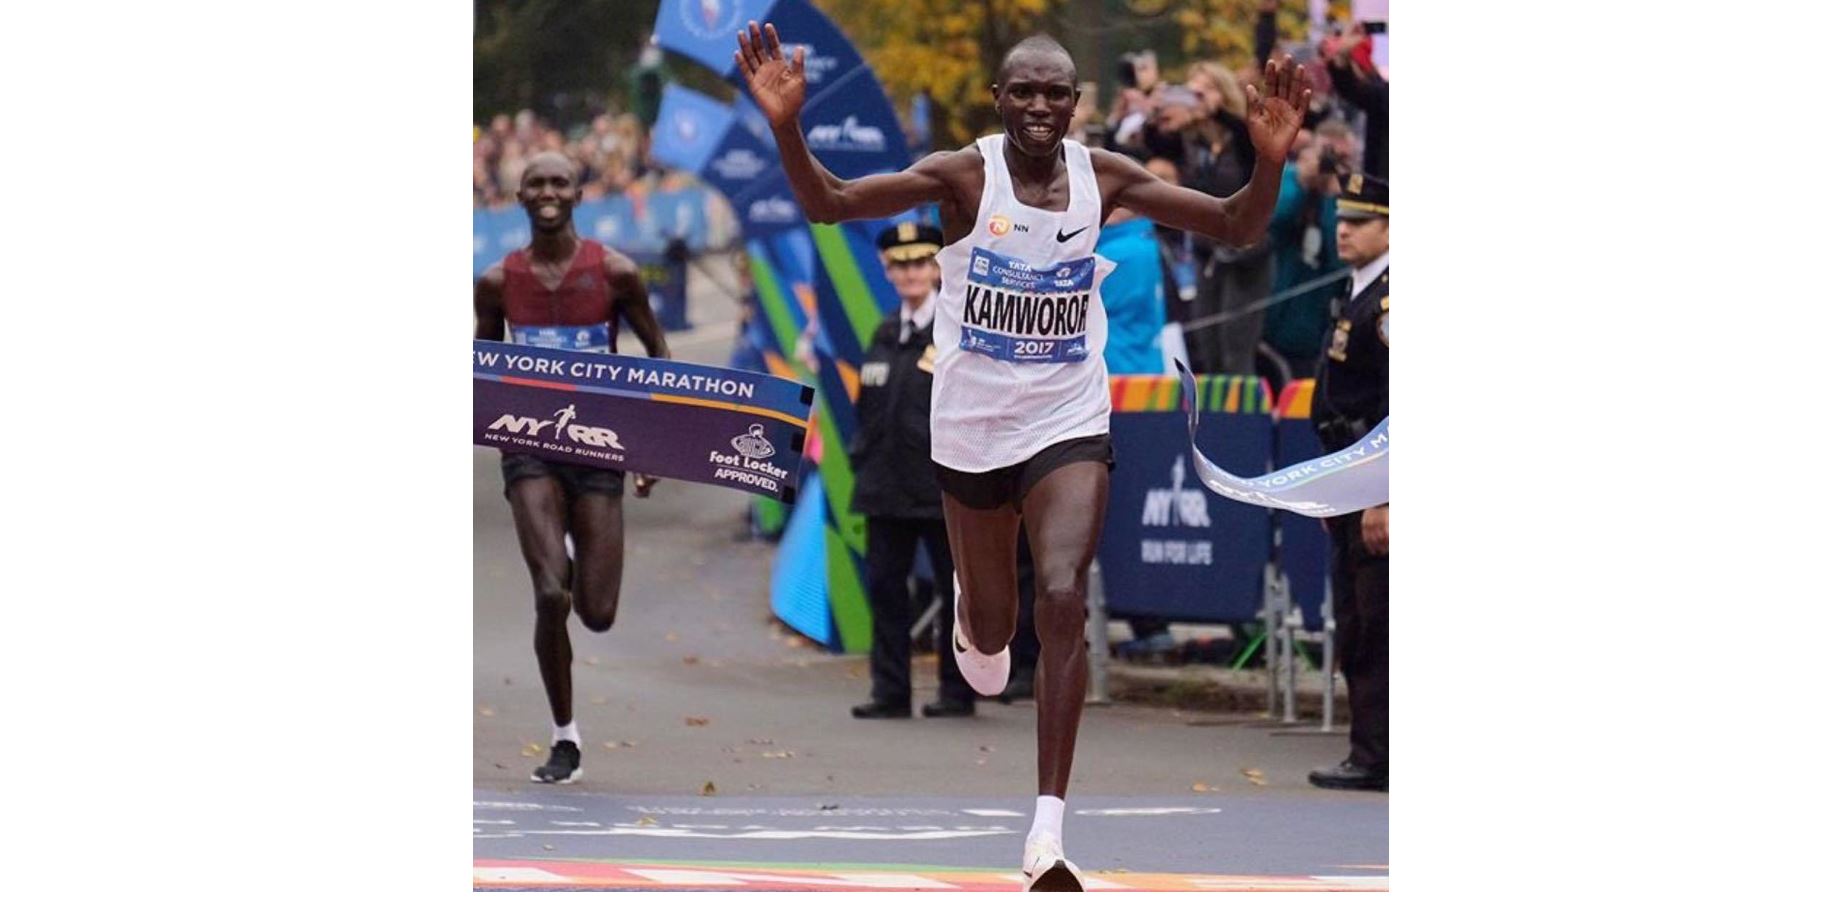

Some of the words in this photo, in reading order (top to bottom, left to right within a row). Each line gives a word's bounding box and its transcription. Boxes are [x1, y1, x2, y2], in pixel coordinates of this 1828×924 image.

[1014, 223, 1029, 232] NN
[1008, 260, 1032, 272] TATA
[1014, 341, 1055, 354] 2017
[473, 350, 499, 366] W
[505, 354, 565, 376] YORK
[570, 362, 622, 381] CITY
[627, 368, 754, 398] MARATHON
[484, 433, 510, 443] NEW
[511, 437, 540, 448] YORK
[542, 442, 573, 453] ROAD
[575, 449, 625, 462] RUNNERS
[1259, 465, 1317, 488] YORK
[1320, 446, 1365, 469] CITY
[1371, 426, 1389, 448] M
[709, 450, 740, 466] Foot
[743, 456, 788, 479] Locker
[714, 468, 778, 492] APPROVED.
